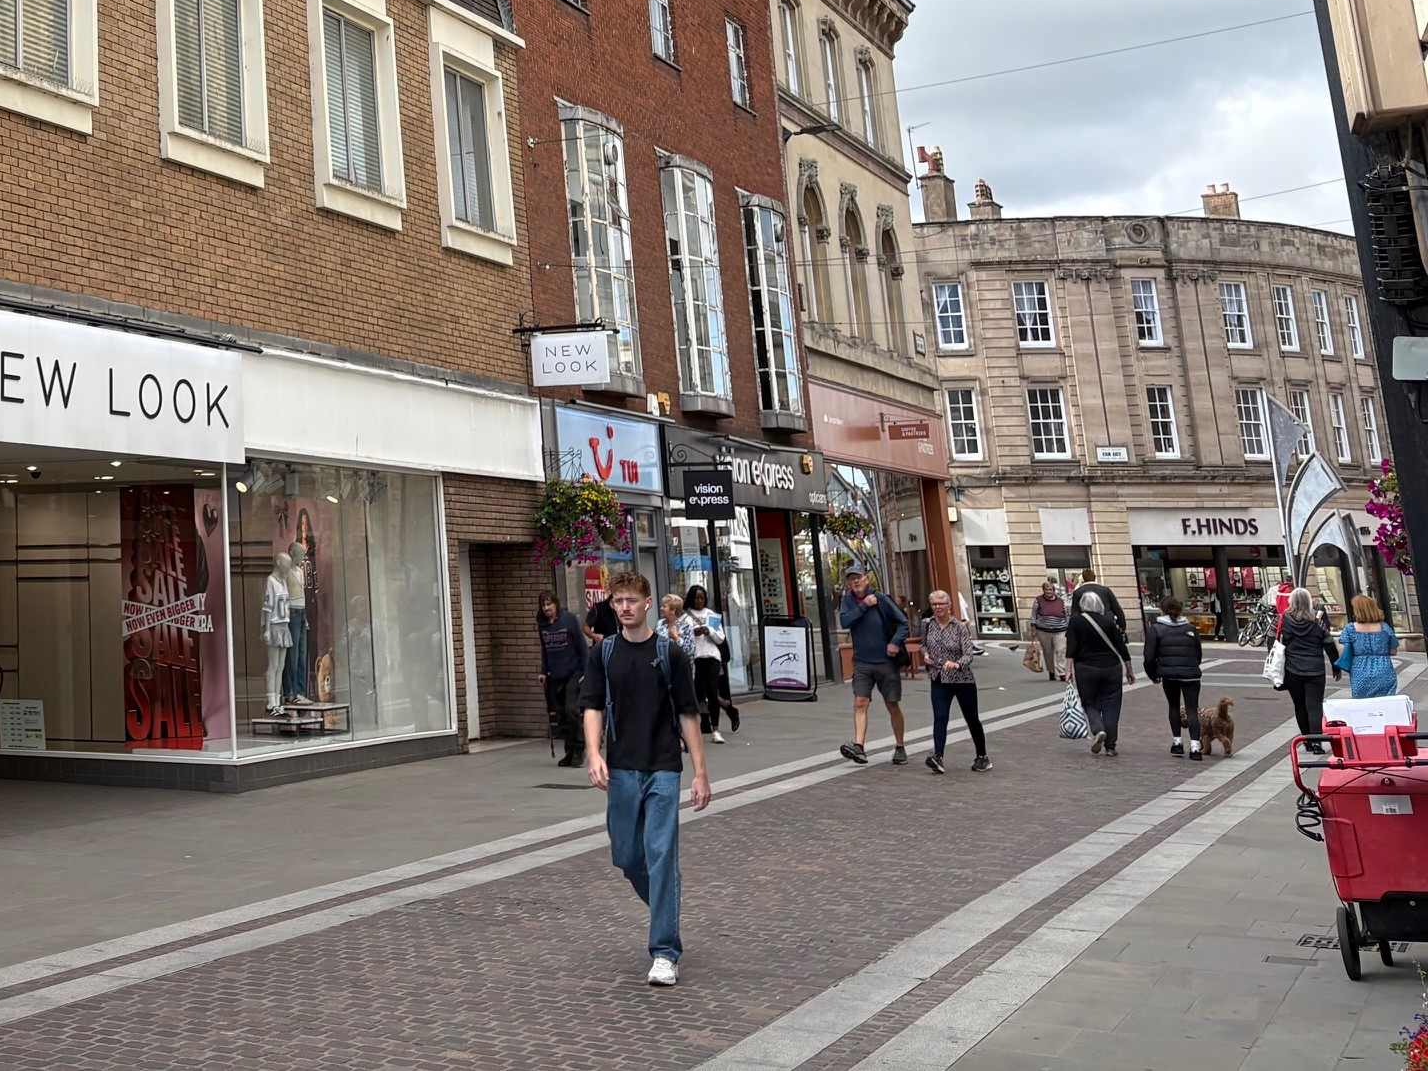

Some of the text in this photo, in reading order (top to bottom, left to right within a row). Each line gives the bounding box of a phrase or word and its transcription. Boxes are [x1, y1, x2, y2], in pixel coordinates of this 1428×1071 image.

[545, 344, 592, 358] NEW
[542, 360, 598, 374] LOOK
[109, 367, 229, 429] LOOK
[620, 459, 640, 484] TUI
[694, 483, 723, 494] vision
[1181, 518, 1259, 536] F.HINDS
[125, 618, 146, 632] NOW
[147, 609, 167, 626] EVEN
[166, 598, 196, 619] BIGGER
[168, 615, 196, 628] IGGER
